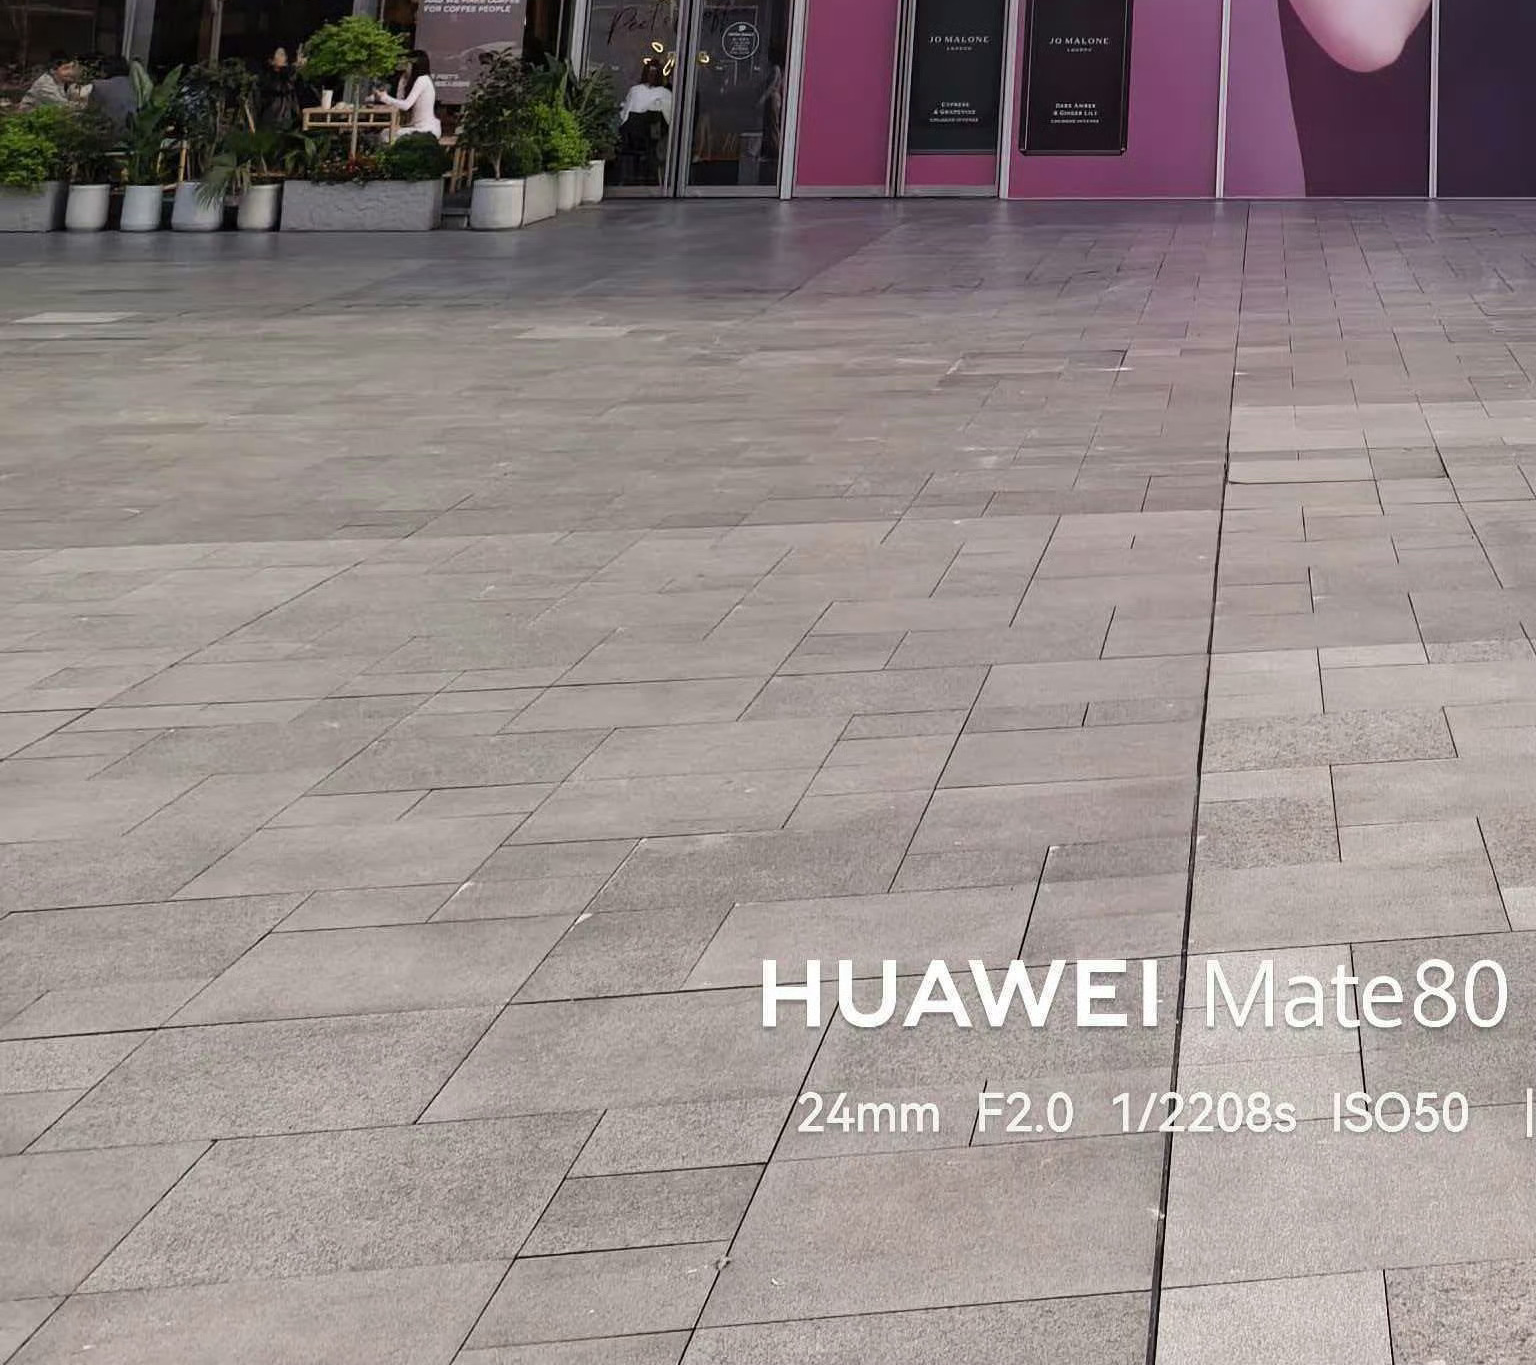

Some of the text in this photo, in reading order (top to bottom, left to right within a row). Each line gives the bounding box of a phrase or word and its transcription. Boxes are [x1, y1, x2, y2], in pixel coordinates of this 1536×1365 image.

[929, 36, 990, 44] JO MALONE
[1049, 37, 1110, 45] JO MALONE
